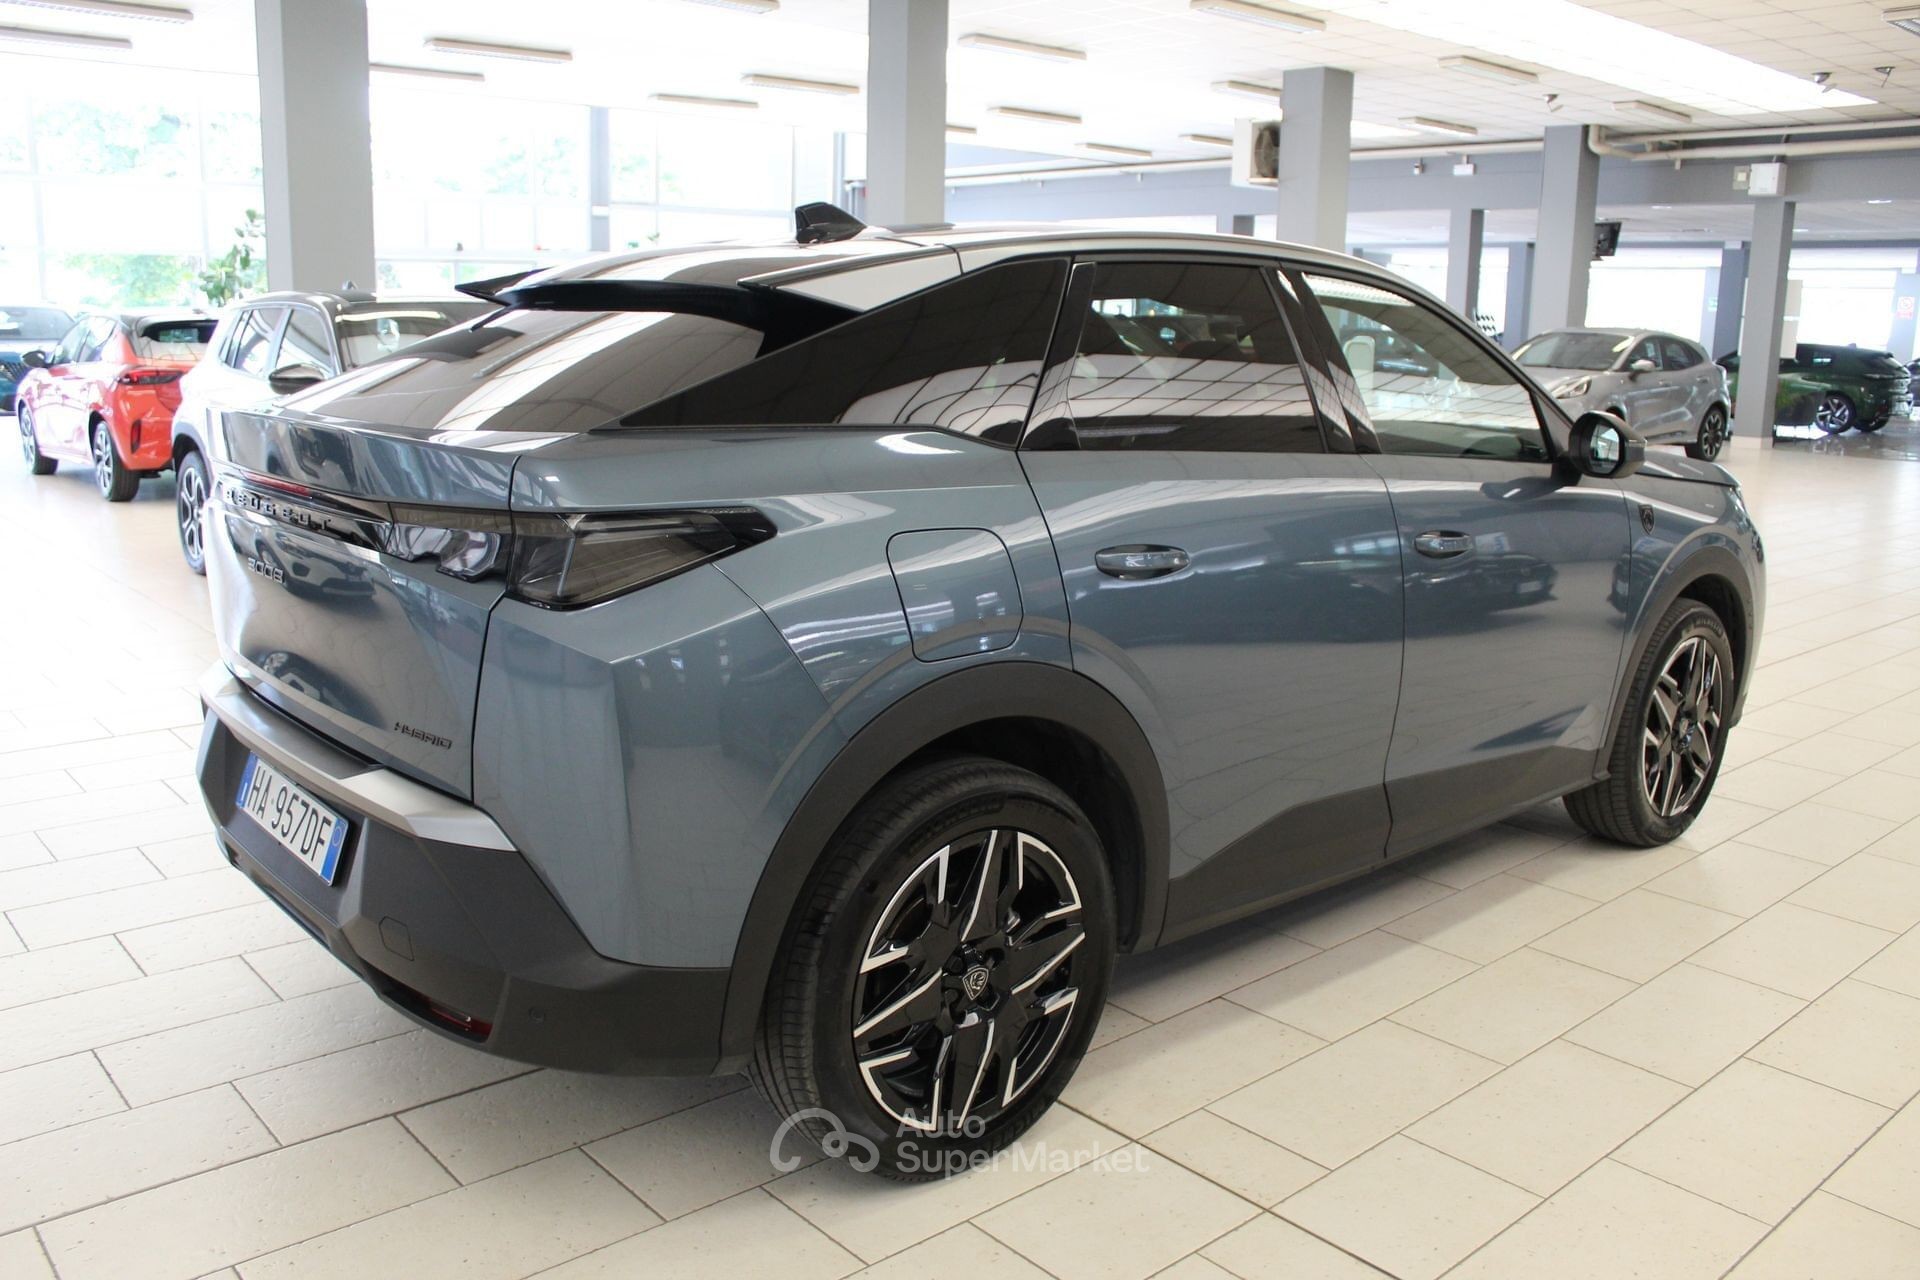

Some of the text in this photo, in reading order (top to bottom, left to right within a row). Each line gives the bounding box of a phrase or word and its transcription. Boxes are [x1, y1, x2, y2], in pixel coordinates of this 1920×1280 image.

[248, 557, 284, 584] 3008
[394, 721, 453, 749] HYBRID
[247, 766, 332, 861] HA 957DF
